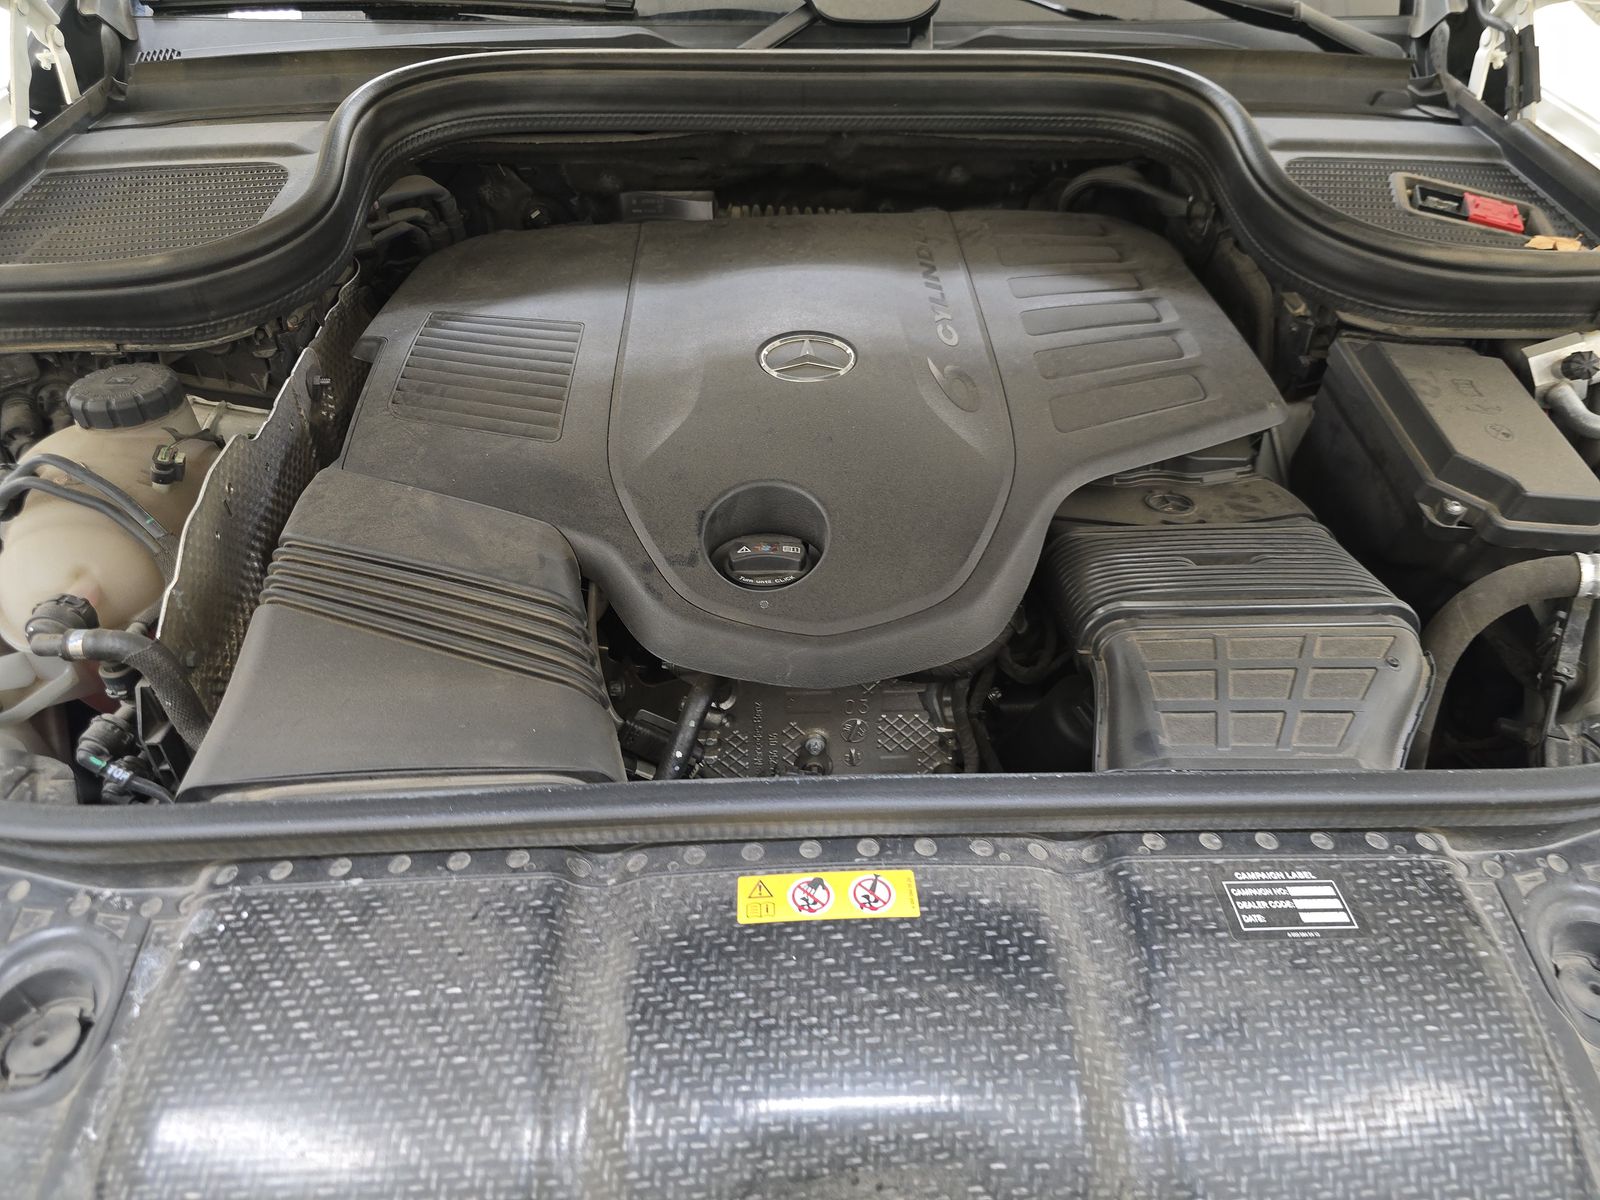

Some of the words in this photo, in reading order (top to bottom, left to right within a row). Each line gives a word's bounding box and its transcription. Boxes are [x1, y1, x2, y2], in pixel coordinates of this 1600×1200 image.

[914, 222, 960, 347] CYLIND
[774, 575, 795, 584] CLICK
[1234, 871, 1285, 880] CAMPAIGN
[1285, 871, 1317, 880] LABEL
[1230, 887, 1272, 896] CAMPAIGN
[1236, 900, 1269, 909] DEALER
[1241, 914, 1267, 923] DATE:
